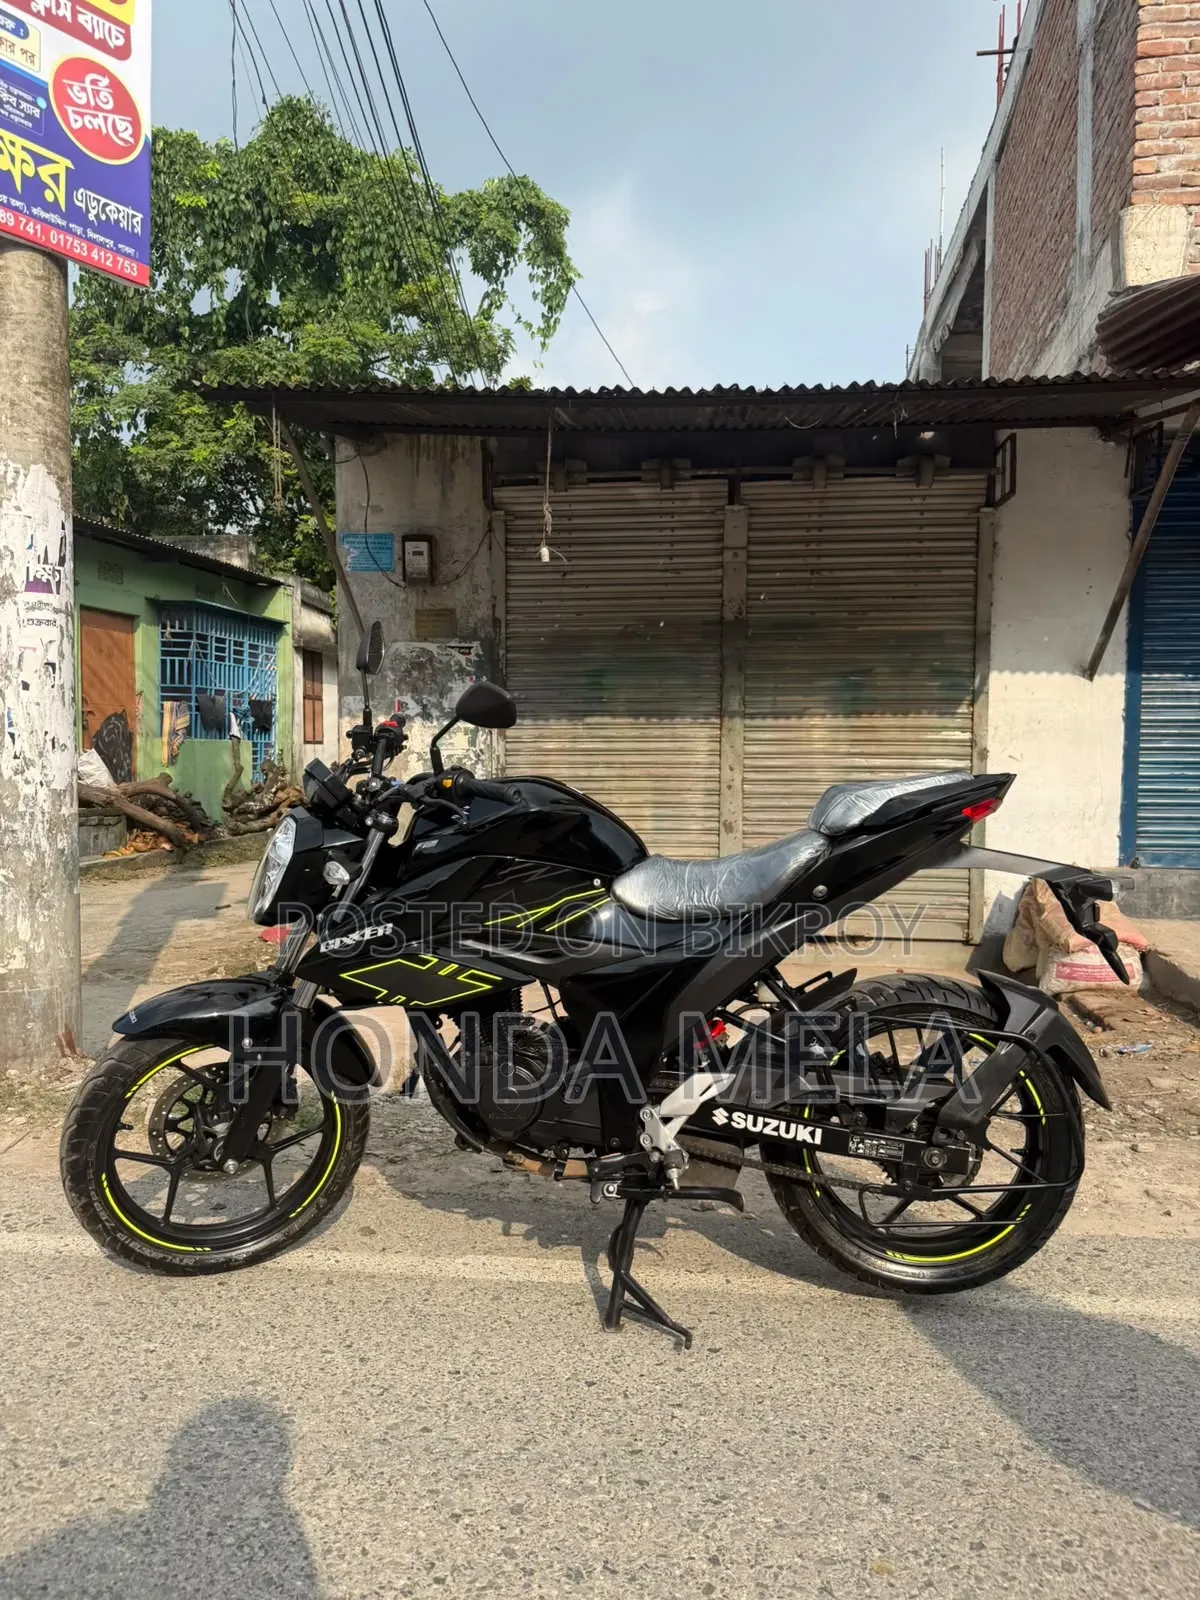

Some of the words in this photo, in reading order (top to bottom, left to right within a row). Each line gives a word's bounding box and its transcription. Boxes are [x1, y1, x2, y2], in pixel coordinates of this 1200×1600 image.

[76, 5, 126, 49] ব্যাচে
[20, 47, 36, 65] পর
[62, 73, 113, 108] ভর্তি
[64, 105, 135, 148] চলছে
[73, 187, 144, 238] এডুকেয়ার
[18, 216, 45, 242] 741,
[50, 230, 88, 257] 01753
[91, 247, 113, 268] 412
[117, 256, 138, 276] 753
[319, 923, 394, 953] GIXXER
[731, 1111, 823, 1146] SUZUKI
